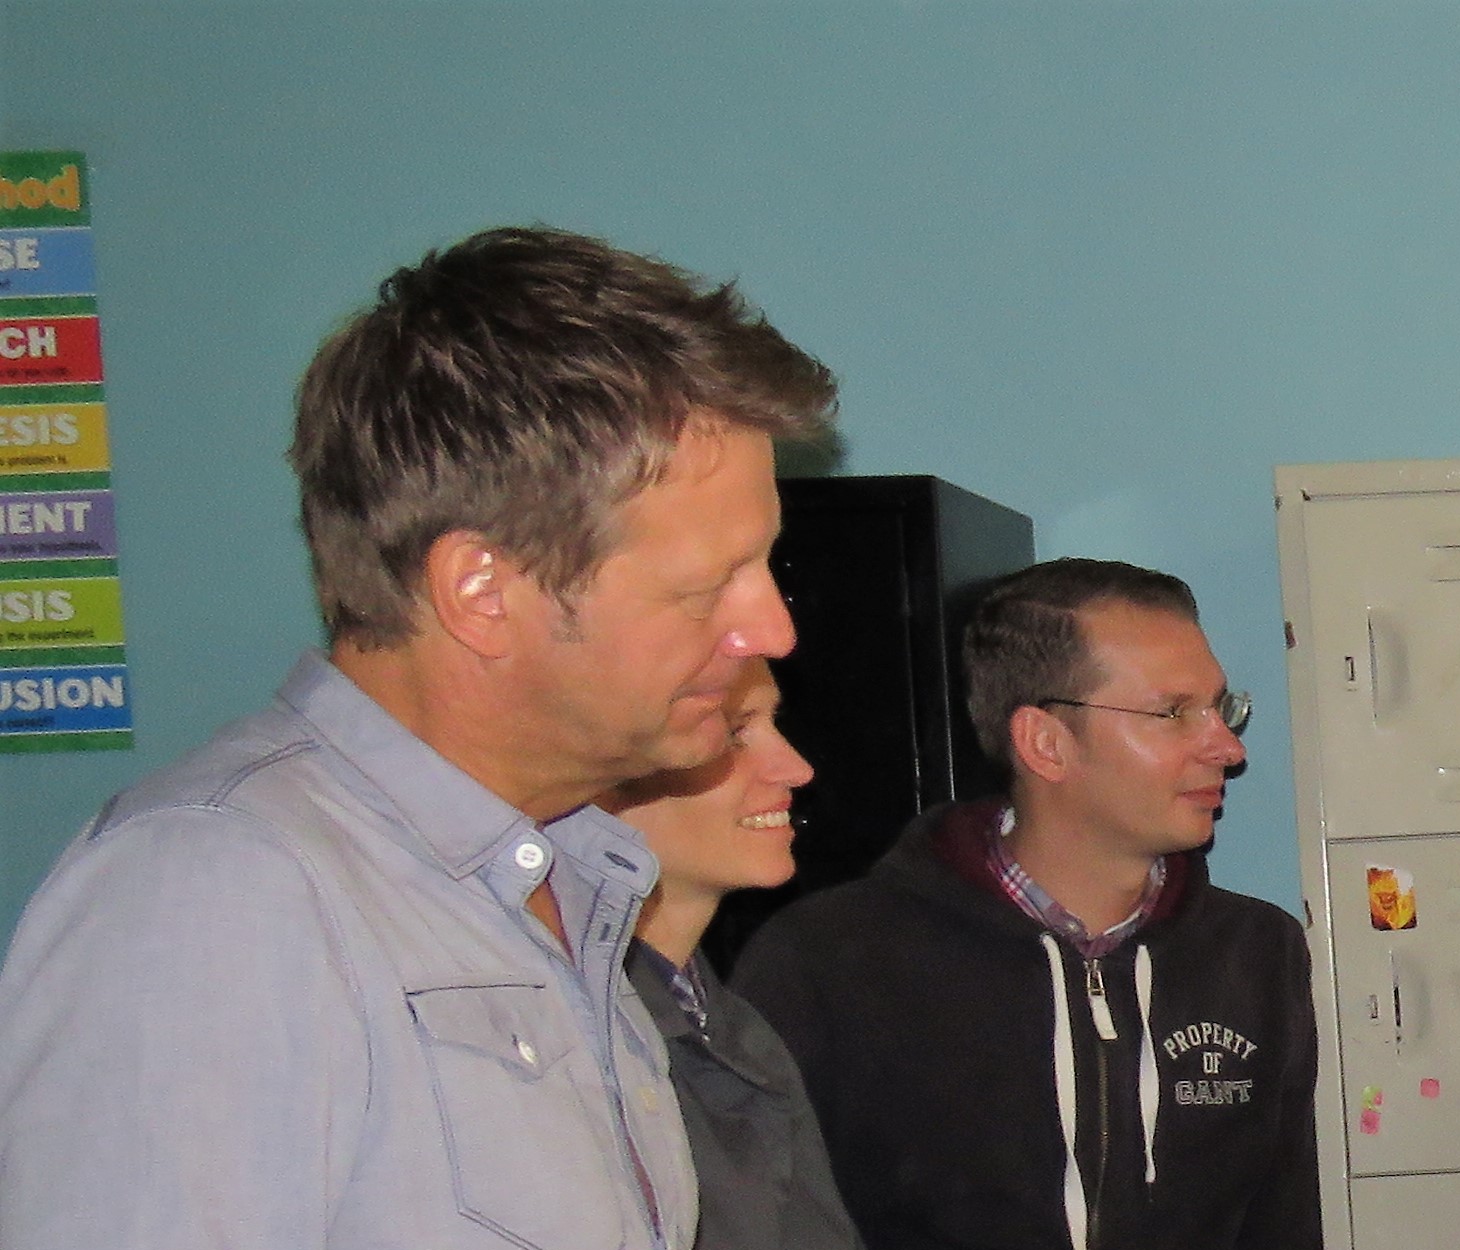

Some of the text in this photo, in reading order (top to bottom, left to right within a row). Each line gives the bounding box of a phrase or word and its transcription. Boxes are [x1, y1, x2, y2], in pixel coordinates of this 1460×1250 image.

[0, 326, 58, 358] CH
[1163, 1022, 1258, 1060] PROPERTY
[1203, 1051, 1224, 1074] OF
[1174, 1080, 1253, 1105] GANT
